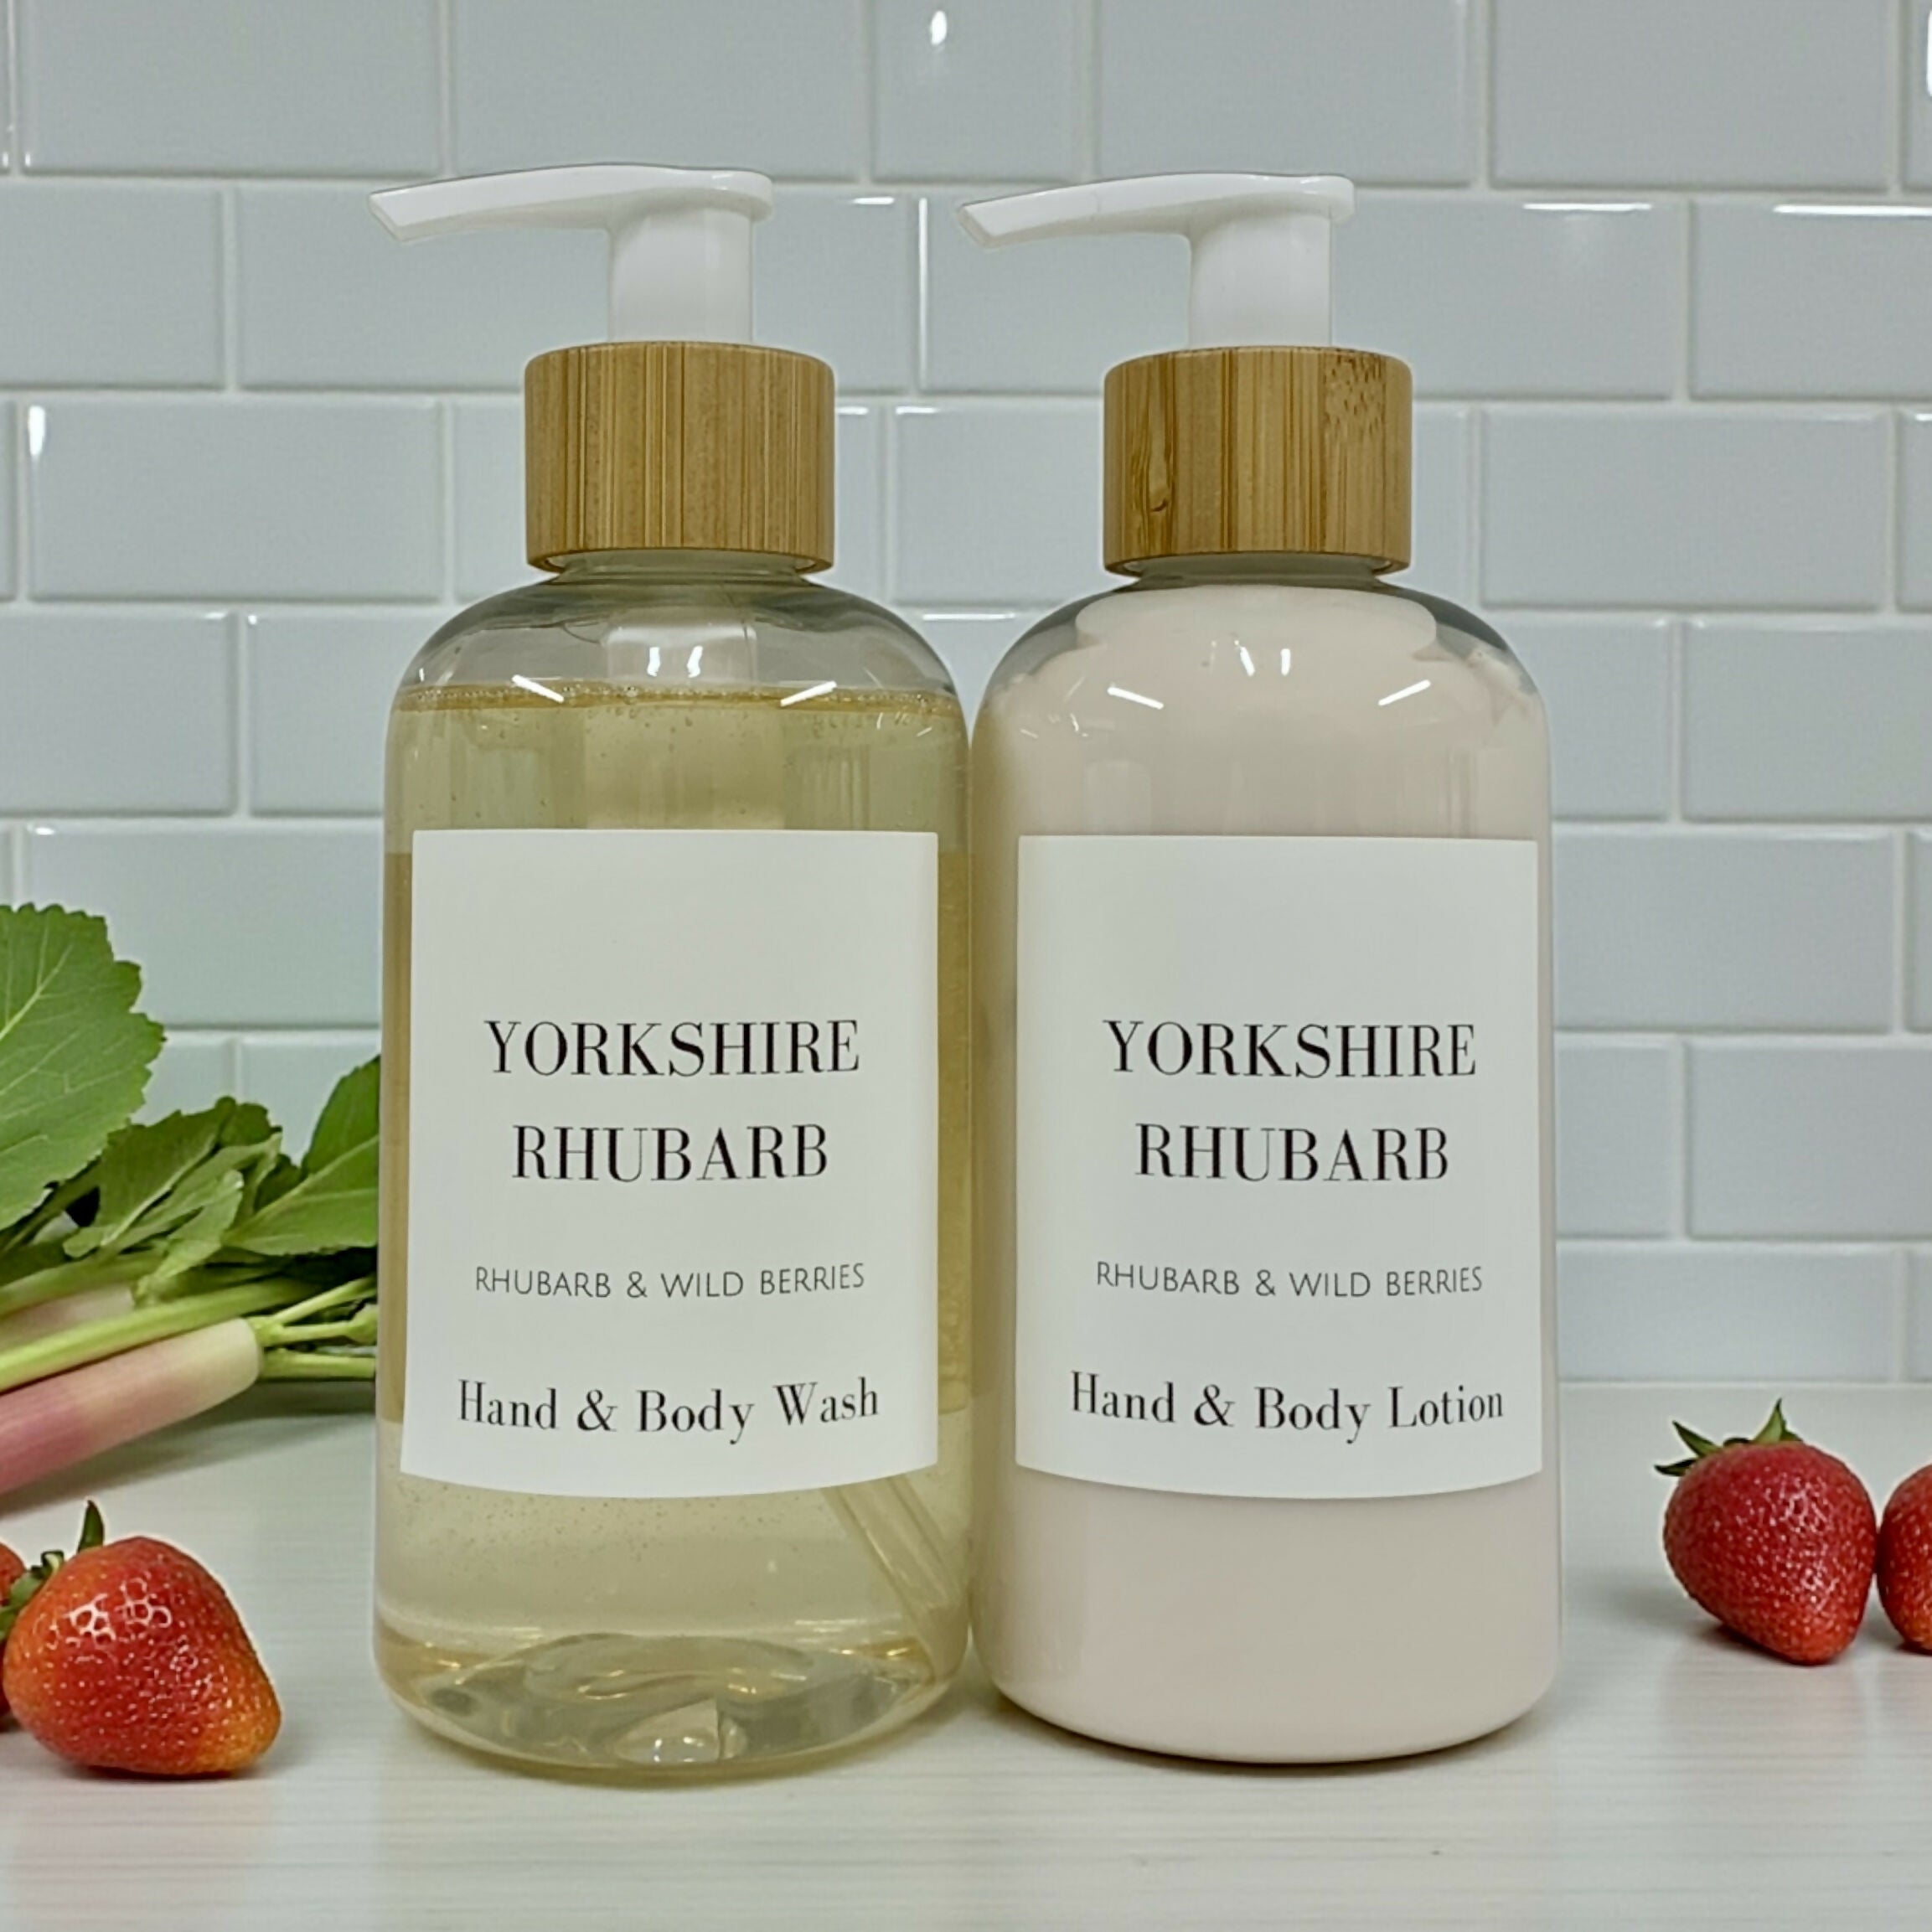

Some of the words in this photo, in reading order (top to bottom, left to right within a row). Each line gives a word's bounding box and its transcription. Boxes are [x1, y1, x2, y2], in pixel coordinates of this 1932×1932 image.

[483, 1020, 859, 1077] YORKSHIRE
[1103, 1020, 1475, 1078] YORKSHIRE
[512, 1124, 827, 1182] RHUBARB
[1135, 1123, 1448, 1182] RHUBARB
[477, 1266, 611, 1298] RHUBARB
[627, 1271, 648, 1299] &
[661, 1271, 743, 1298] WILD
[761, 1263, 864, 1295] BERRIES
[1098, 1261, 1239, 1295] RHUBARB
[1256, 1269, 1276, 1296] &
[1289, 1272, 1371, 1297] WILD
[1387, 1266, 1482, 1296] BERRIES
[459, 1379, 556, 1429] Hand
[577, 1389, 617, 1431] &
[638, 1388, 754, 1445] Body
[773, 1377, 877, 1425] Wash
[1072, 1371, 1175, 1423] Hand
[1194, 1384, 1235, 1427] &
[1254, 1387, 1371, 1444] Body
[1388, 1385, 1503, 1428] Lotion
